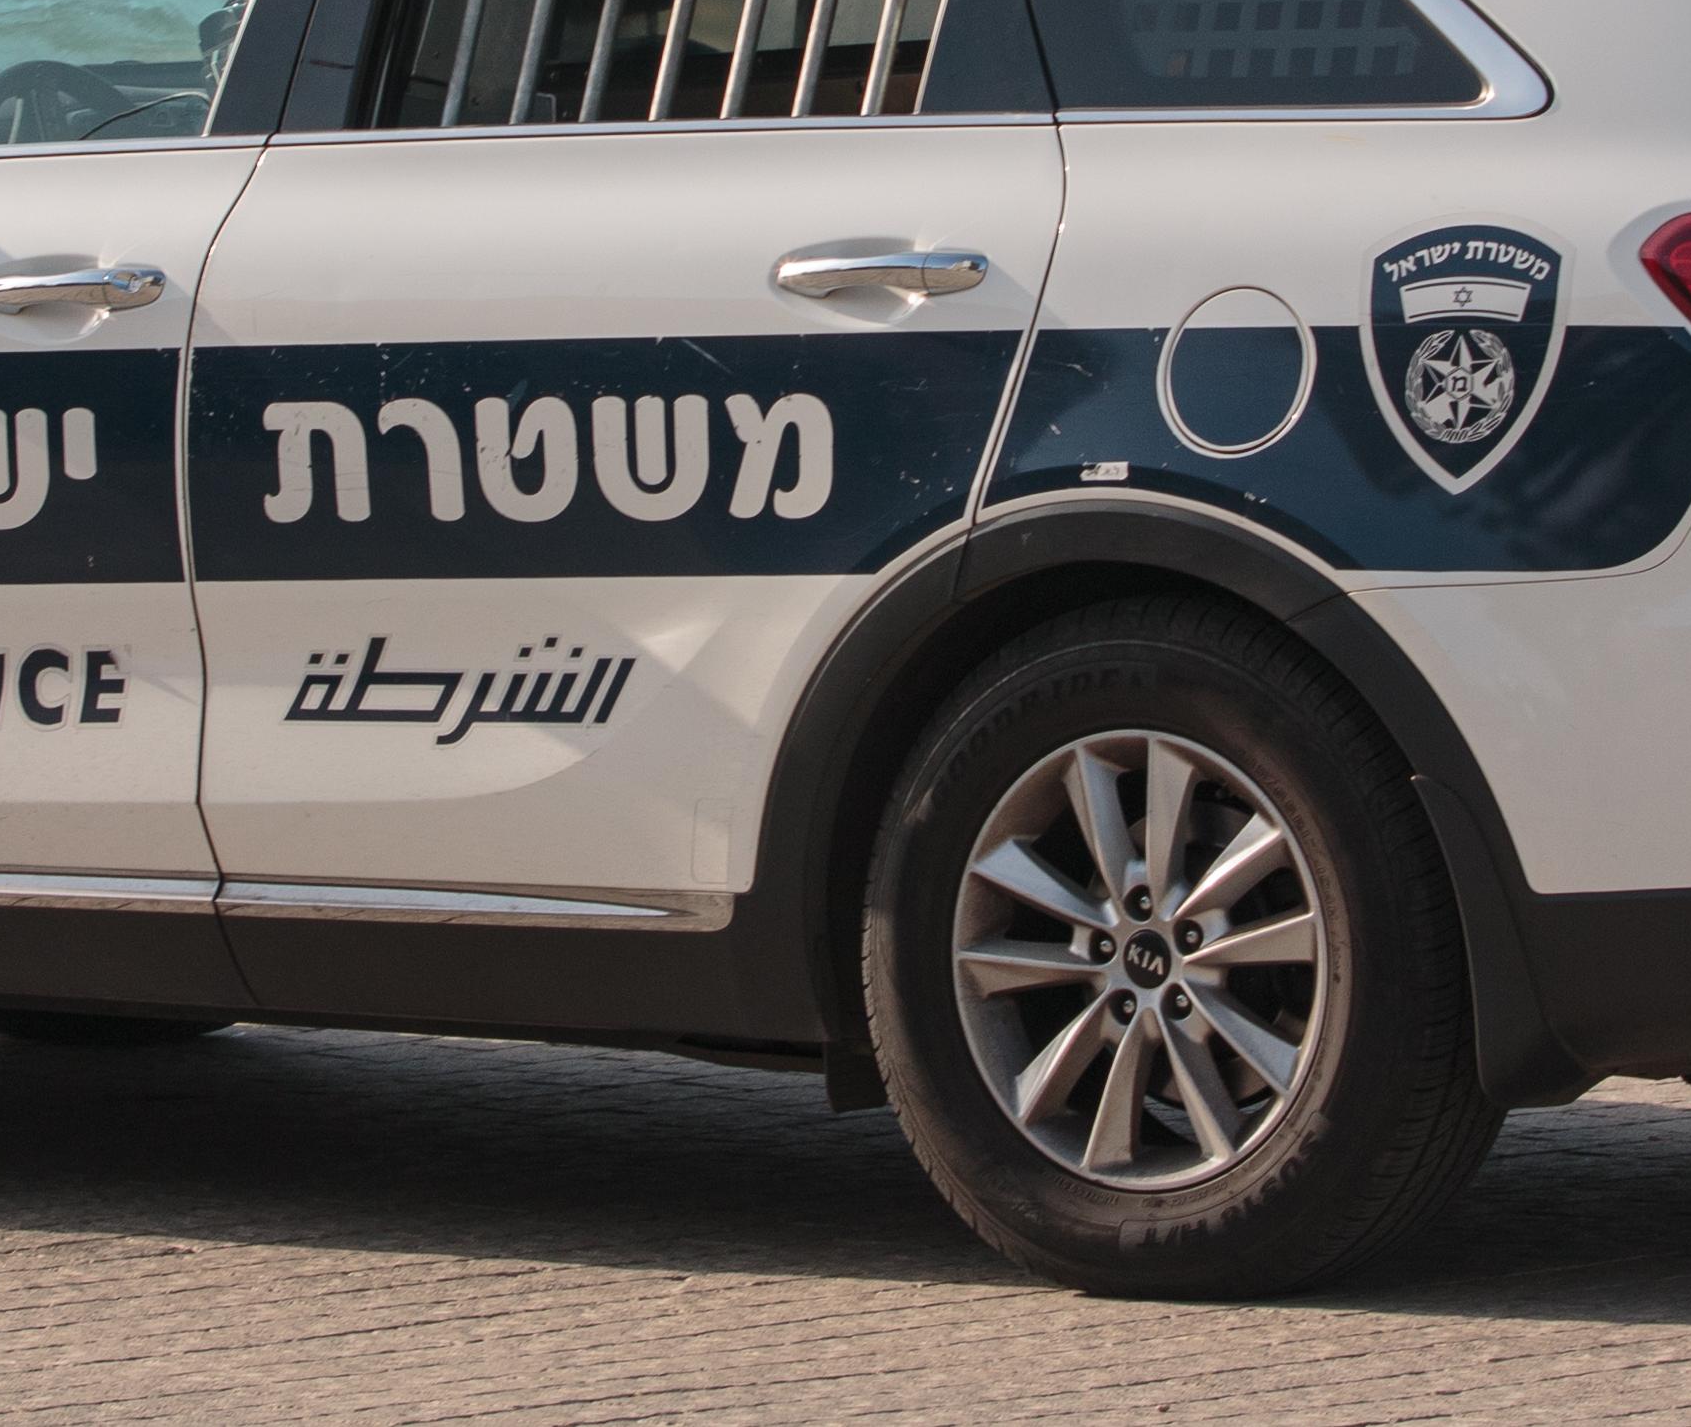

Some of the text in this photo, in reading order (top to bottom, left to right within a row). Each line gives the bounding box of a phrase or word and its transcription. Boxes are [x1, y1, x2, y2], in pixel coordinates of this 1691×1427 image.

[1383, 240, 1551, 282] משטרת ישראל
[263, 394, 834, 524] משטרת
[284, 636, 636, 746] الشرطة
[1127, 943, 1164, 975] KIA
